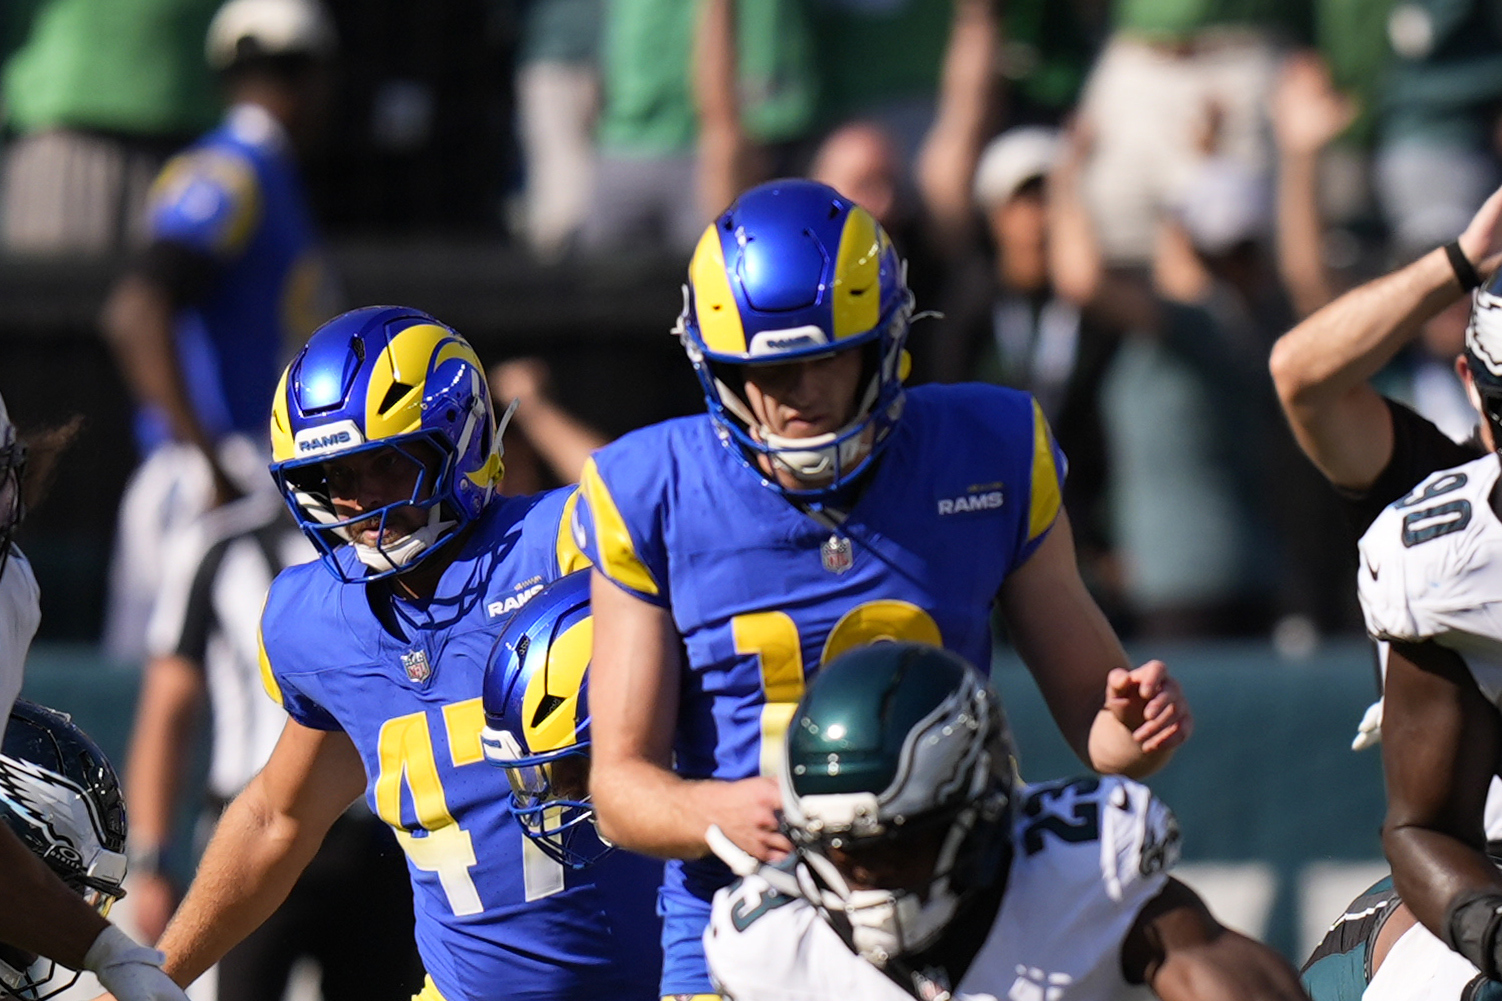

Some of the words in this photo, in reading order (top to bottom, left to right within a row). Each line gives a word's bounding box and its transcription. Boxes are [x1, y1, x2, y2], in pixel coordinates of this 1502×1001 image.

[298, 430, 352, 453] RAMS
[937, 490, 1004, 516] RAMS
[1394, 471, 1473, 549] 90
